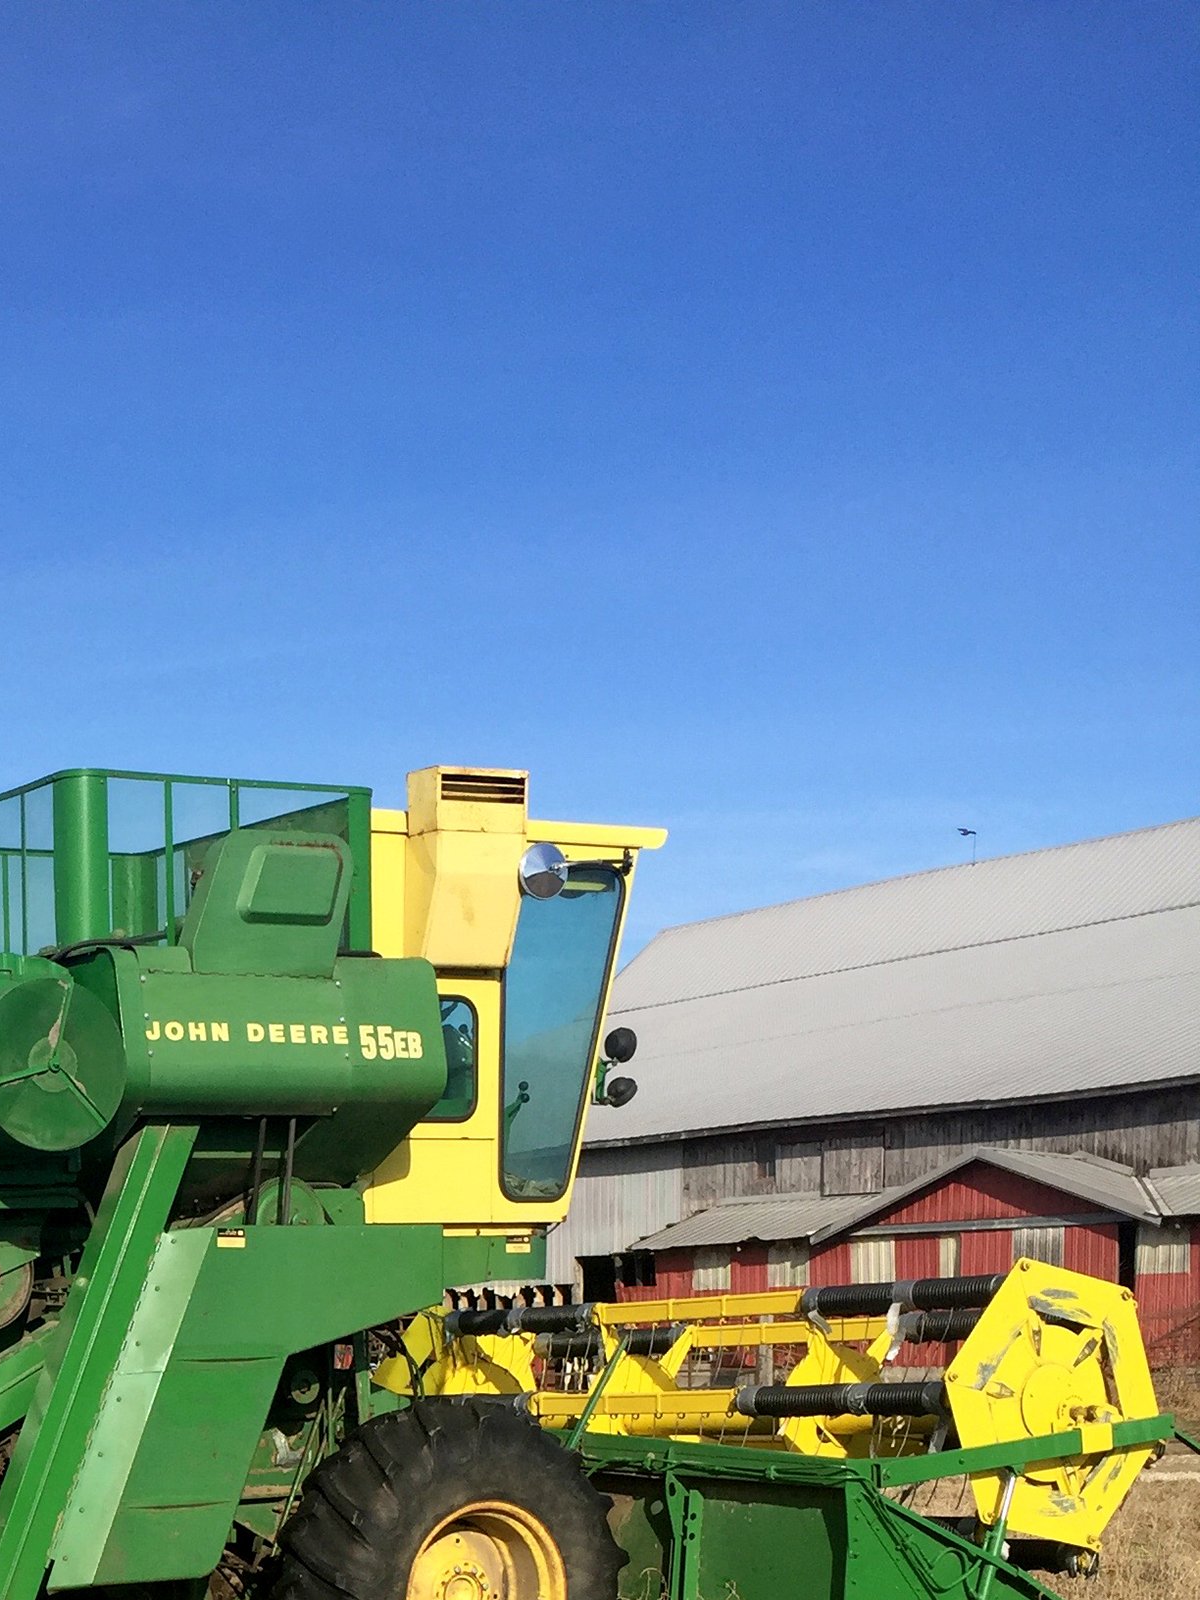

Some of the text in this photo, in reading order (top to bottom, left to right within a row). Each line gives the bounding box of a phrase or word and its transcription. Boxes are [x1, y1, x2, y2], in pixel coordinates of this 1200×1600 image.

[145, 1020, 423, 1060] JOHN DEERE 55EB
